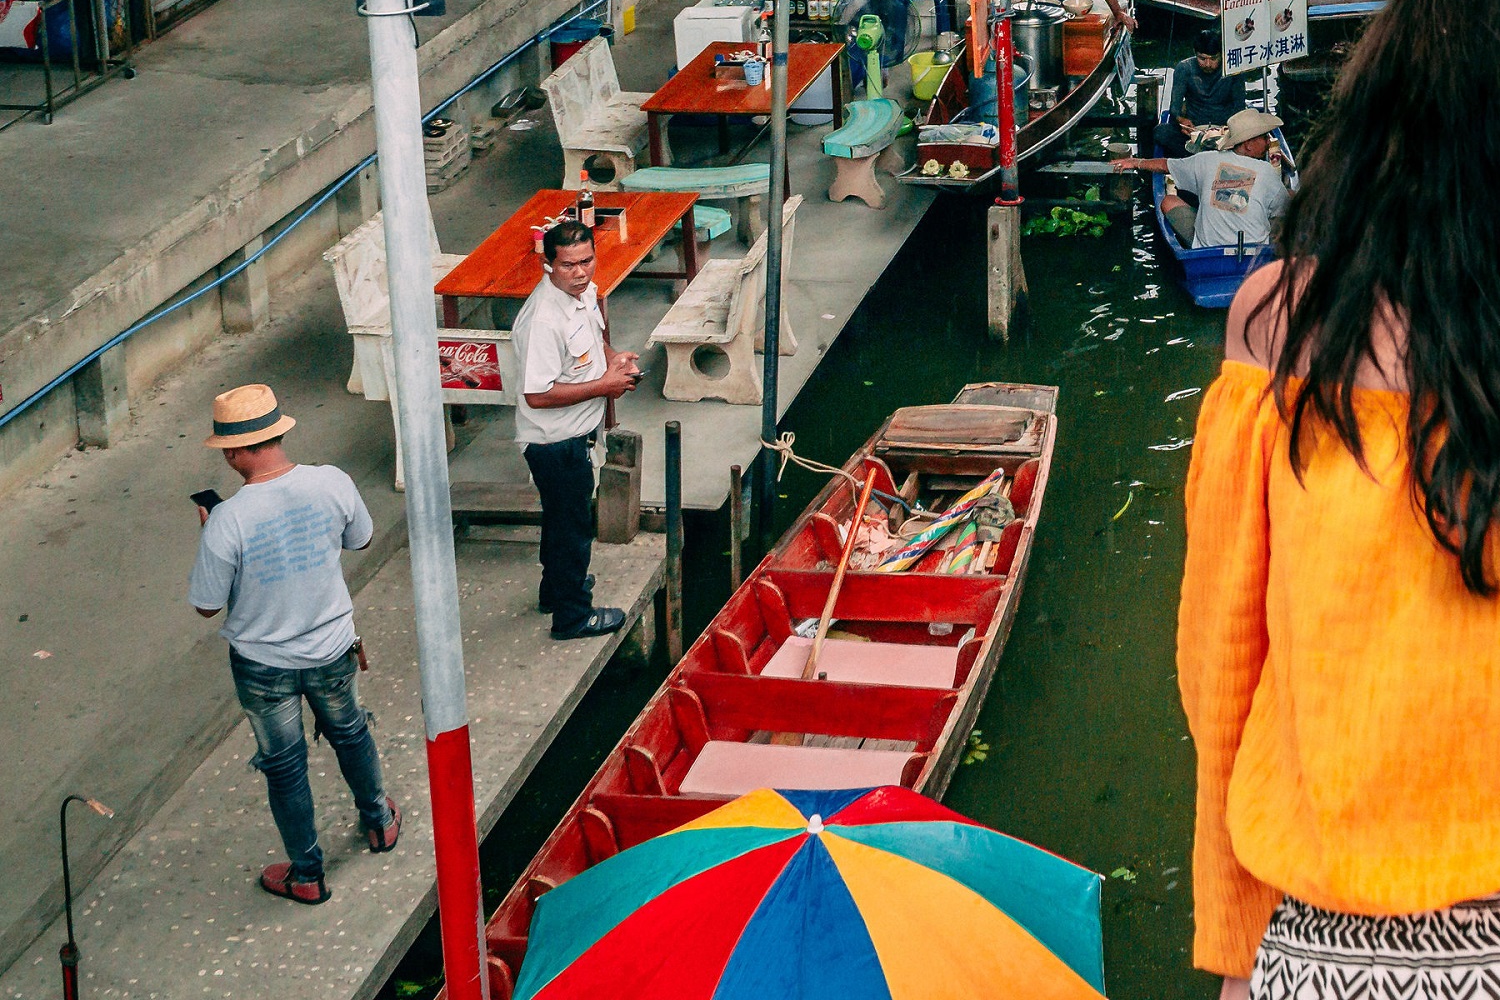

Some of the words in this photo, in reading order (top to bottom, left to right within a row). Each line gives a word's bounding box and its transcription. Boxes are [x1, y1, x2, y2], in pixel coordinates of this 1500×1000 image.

[1227, 33, 1306, 69] 椰子冰淇淋
[438, 342, 491, 363] ca-Cola
